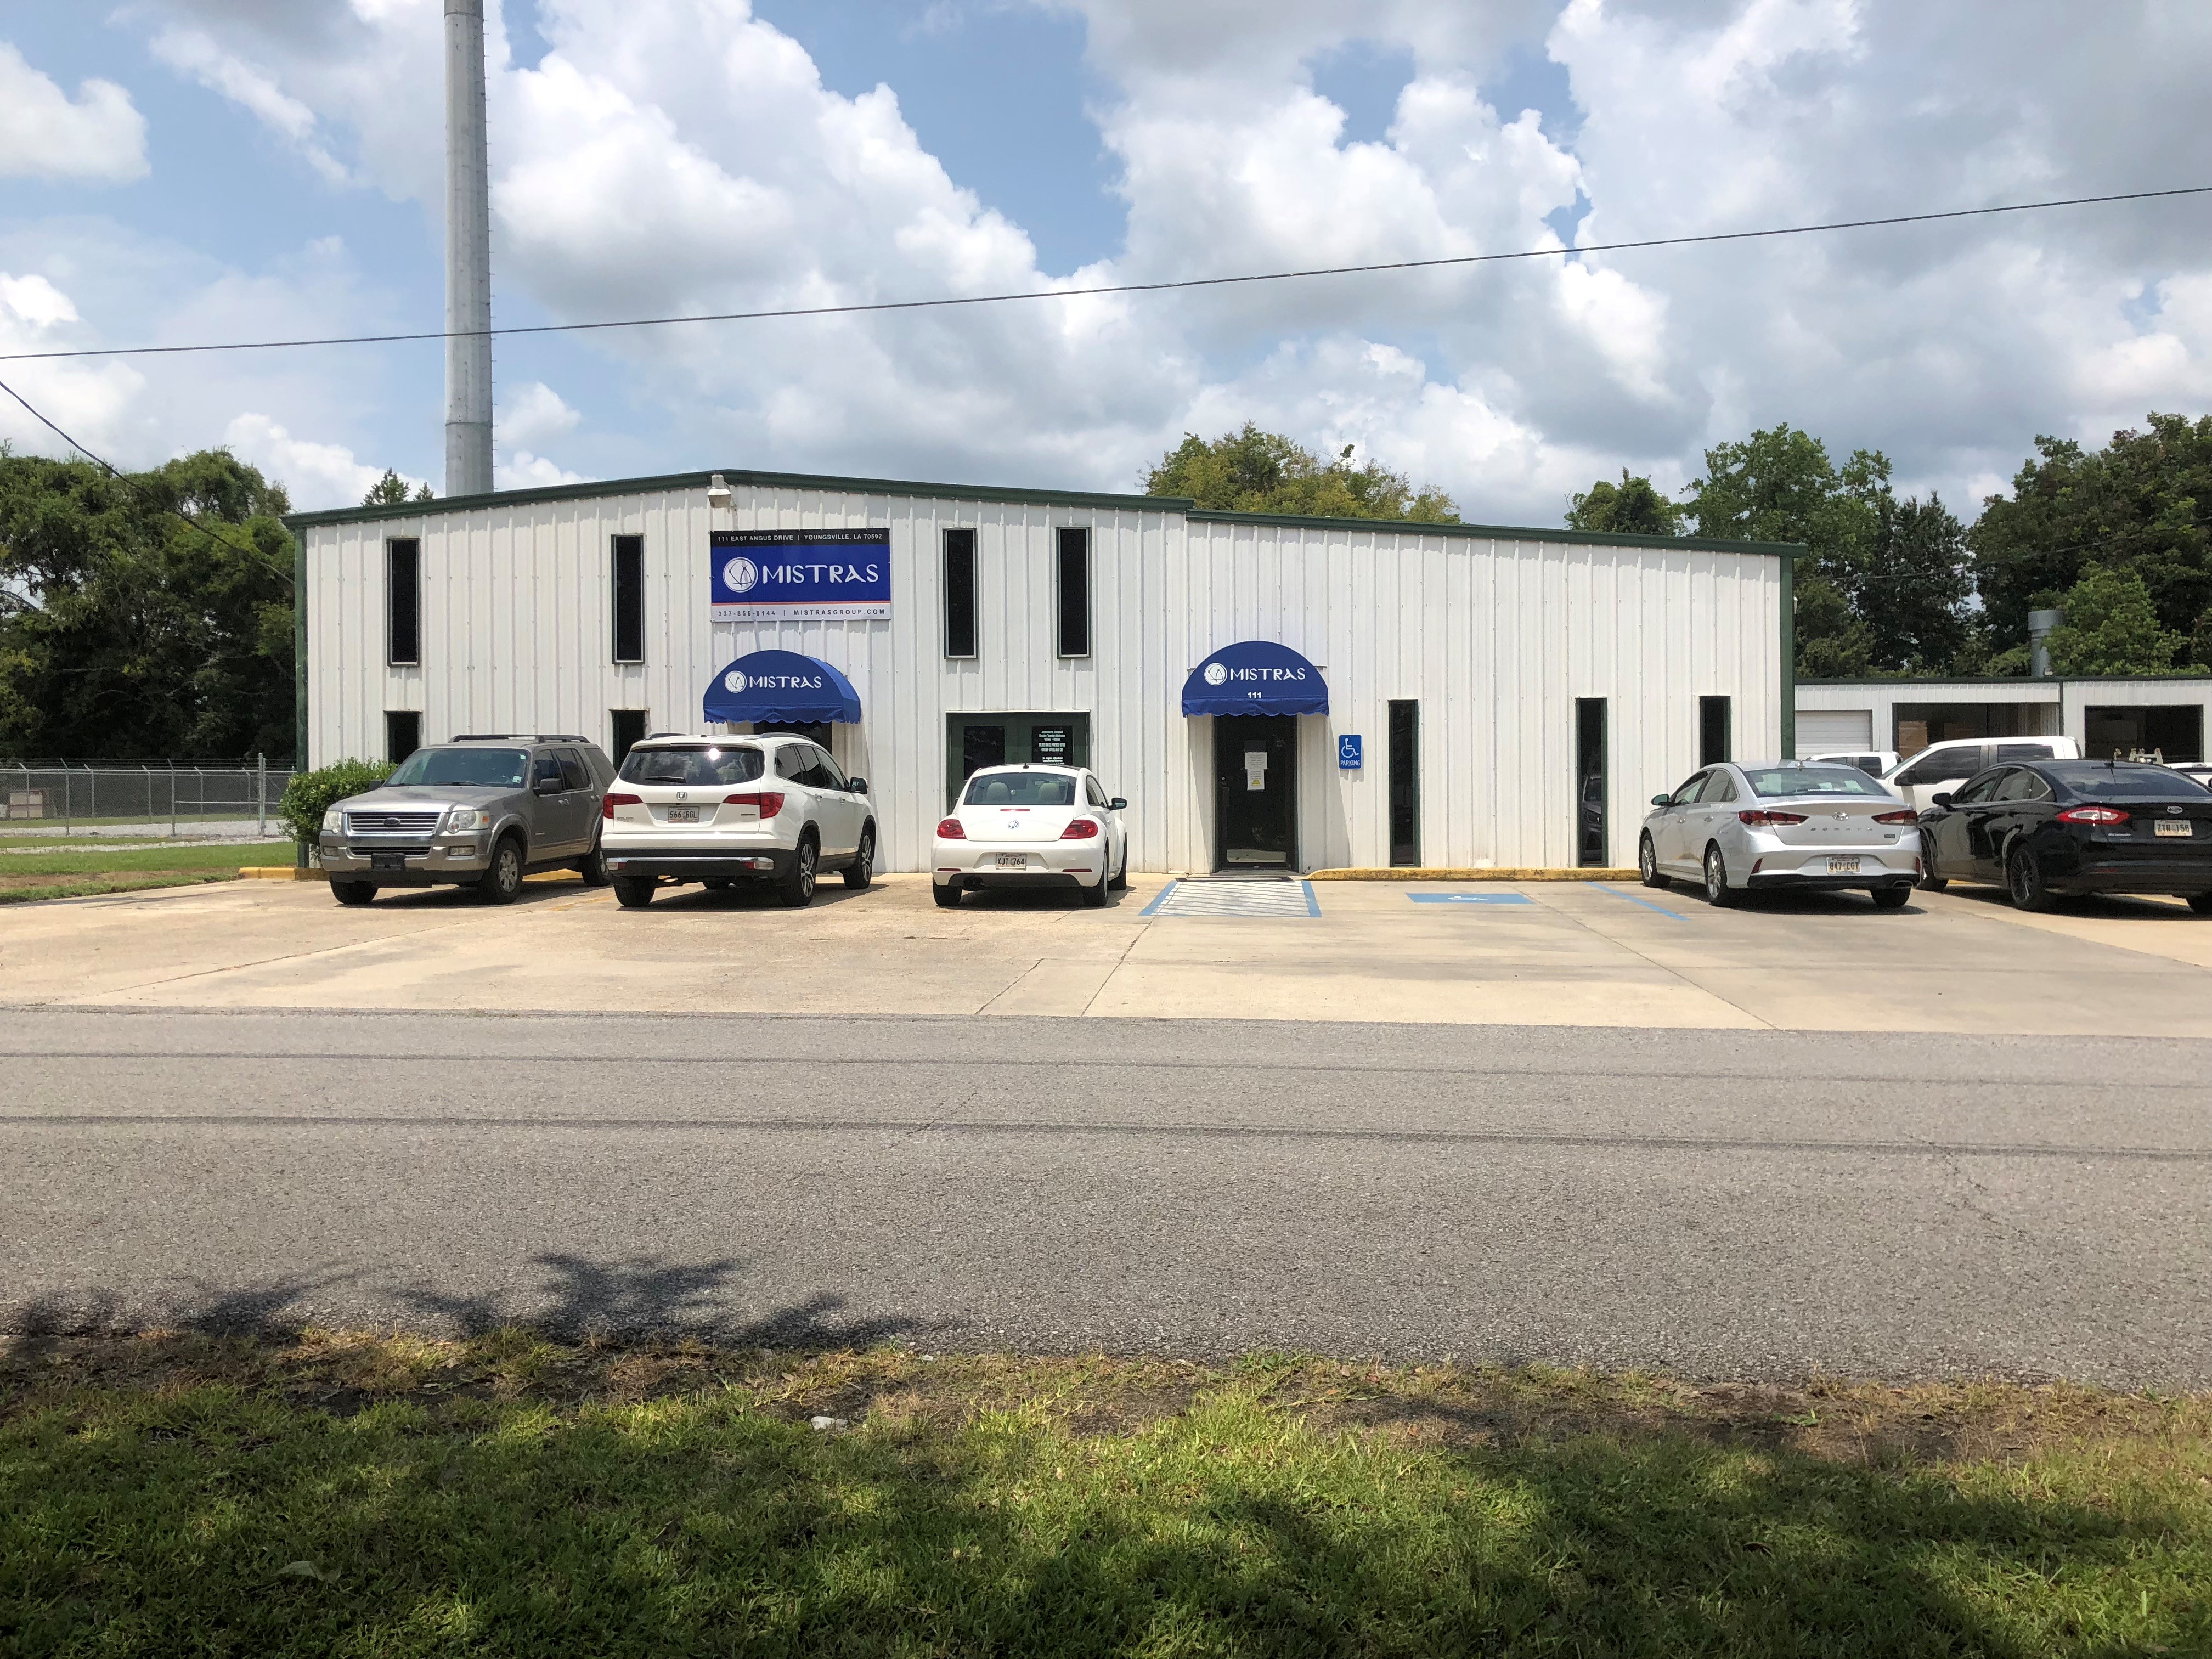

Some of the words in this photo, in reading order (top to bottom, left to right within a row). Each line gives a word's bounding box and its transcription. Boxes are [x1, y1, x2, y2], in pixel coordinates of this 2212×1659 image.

[763, 564, 878, 584] MISTRAS
[1231, 668, 1306, 681] MISTRAS
[749, 676, 822, 689] MISTRAS
[1830, 862, 1842, 870] 847
[1846, 862, 1859, 870] CGT
